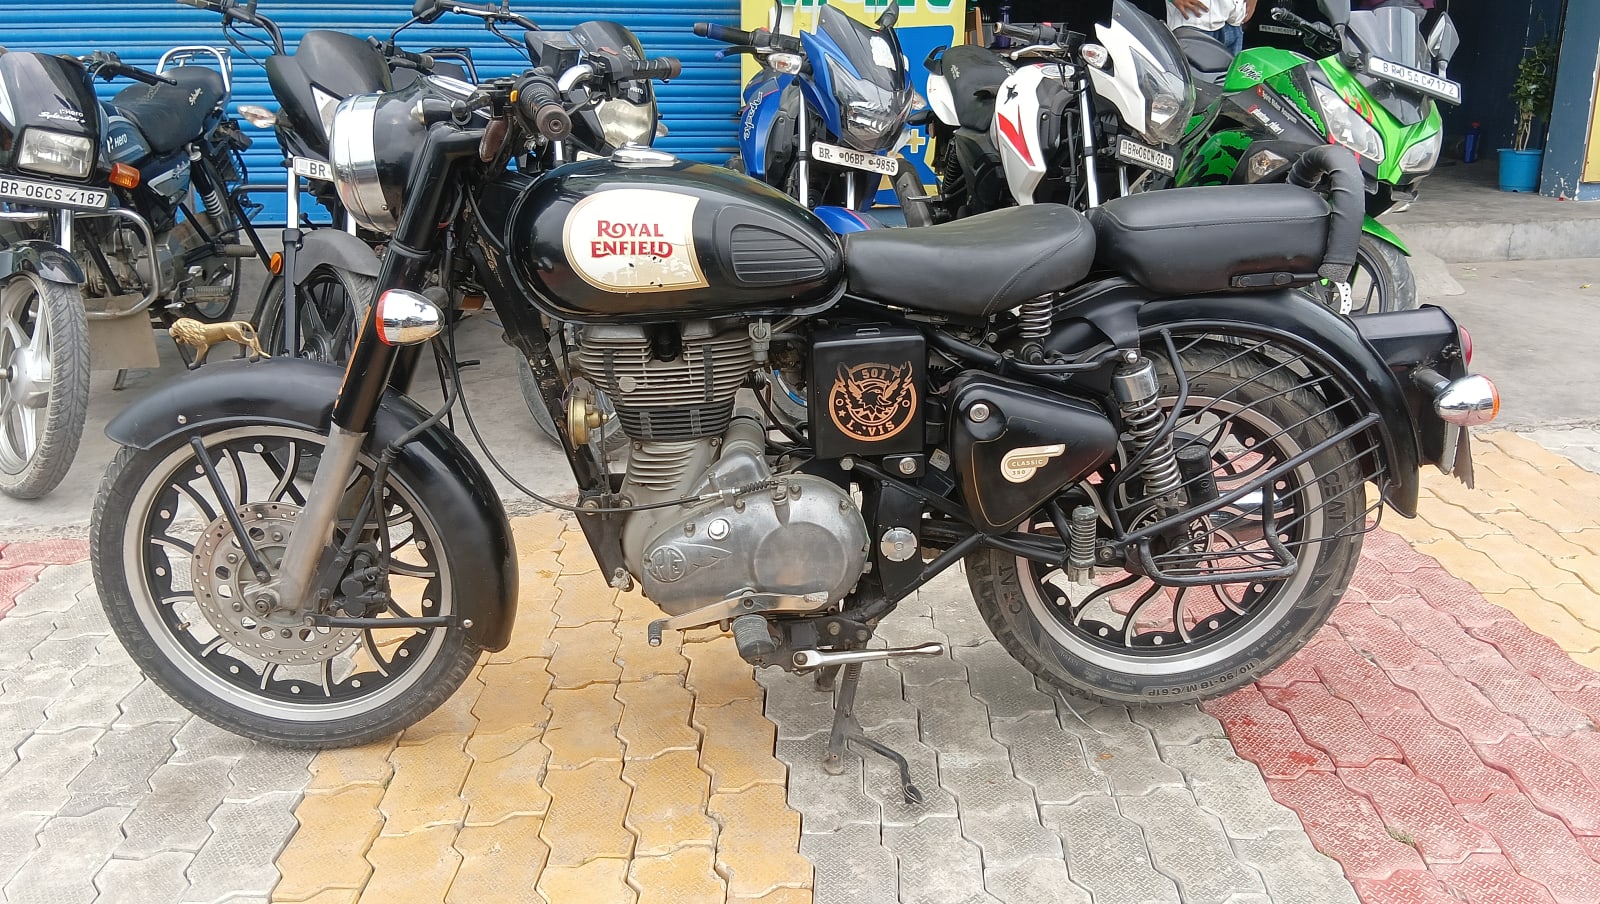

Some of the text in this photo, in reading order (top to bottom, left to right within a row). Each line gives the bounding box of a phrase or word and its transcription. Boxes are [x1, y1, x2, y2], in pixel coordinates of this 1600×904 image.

[115, 133, 128, 147] Hero
[844, 152, 865, 165] 06BP
[309, 162, 326, 176] BR
[1, 181, 104, 205] BR 06CS 4187
[597, 220, 664, 238] ROYAL
[591, 241, 673, 258] ENFIELD
[862, 368, 887, 379] 501
[846, 419, 895, 436] LVIS
[1011, 459, 1043, 467] CLASSIC
